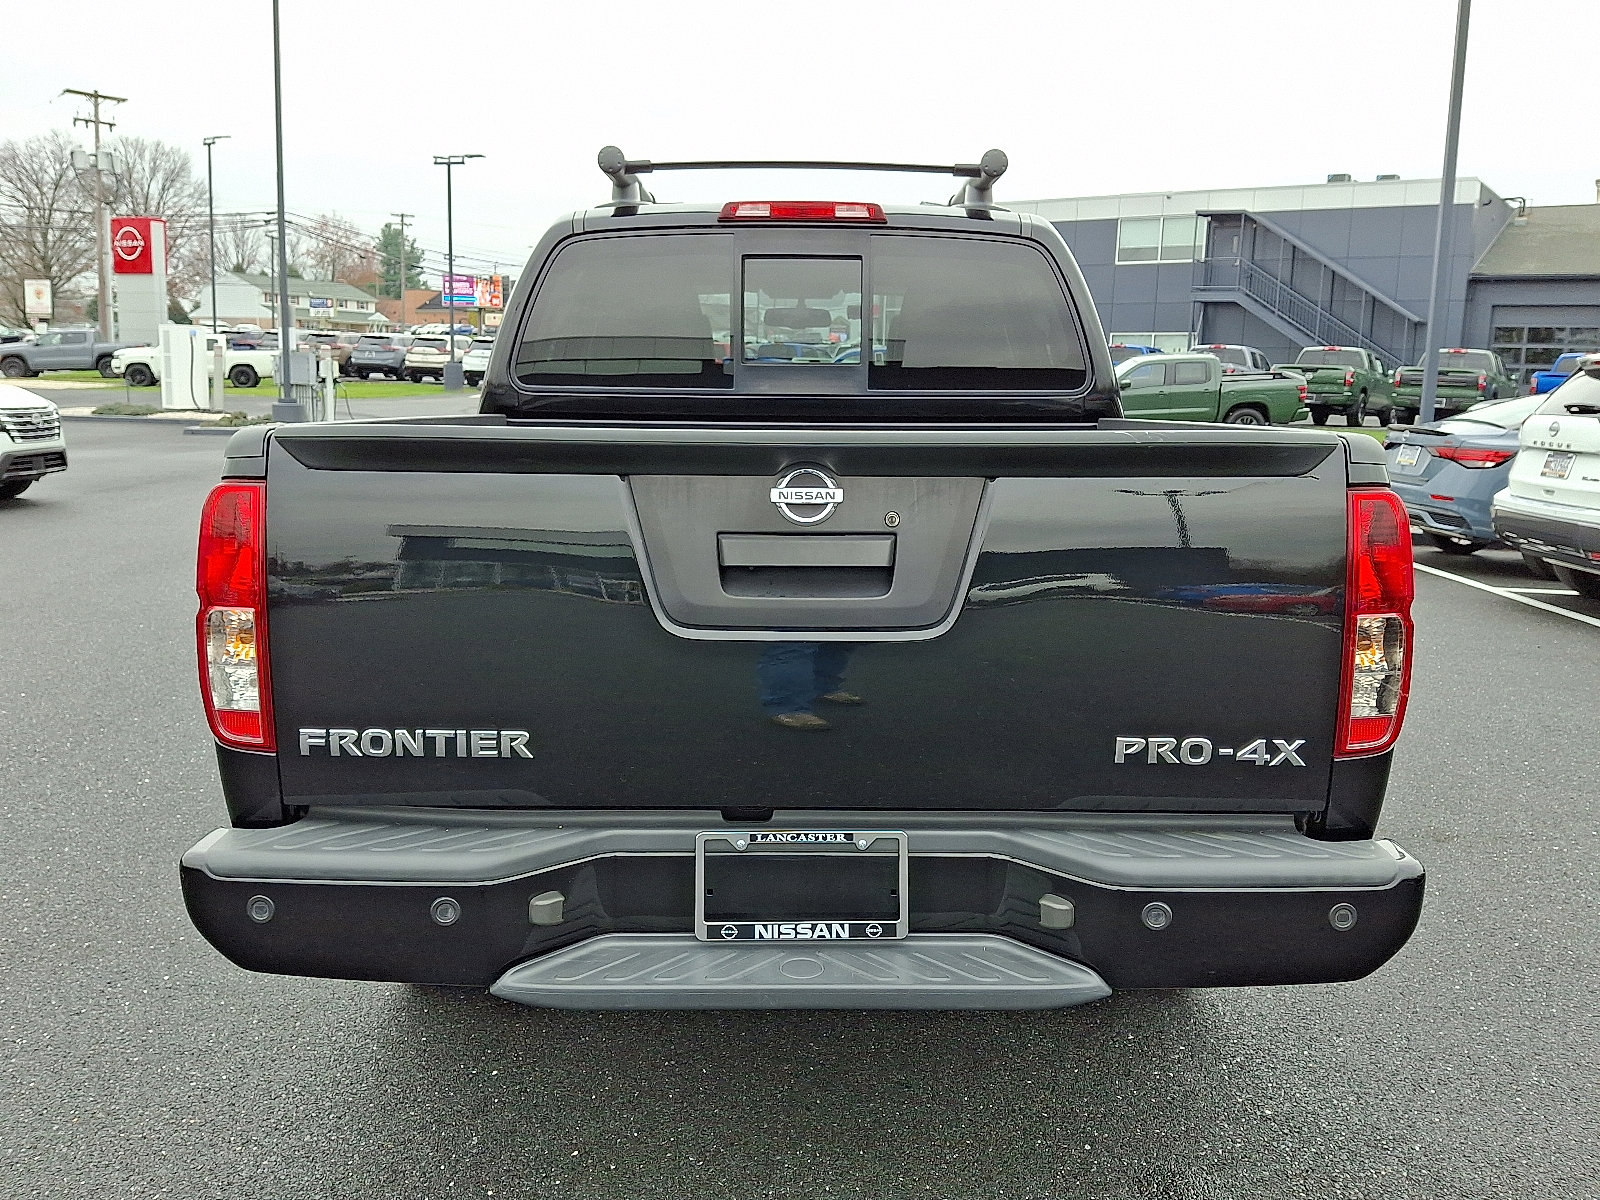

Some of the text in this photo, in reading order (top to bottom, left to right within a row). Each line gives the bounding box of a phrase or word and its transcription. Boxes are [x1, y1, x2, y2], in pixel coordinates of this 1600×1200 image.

[114, 239, 145, 248] NISSAN
[778, 491, 836, 500] NISSAN
[298, 728, 534, 759] FRONTIER
[1114, 736, 1307, 767] PRO-4X
[756, 833, 848, 843] LANCASTER
[754, 924, 850, 939] NISSAN
